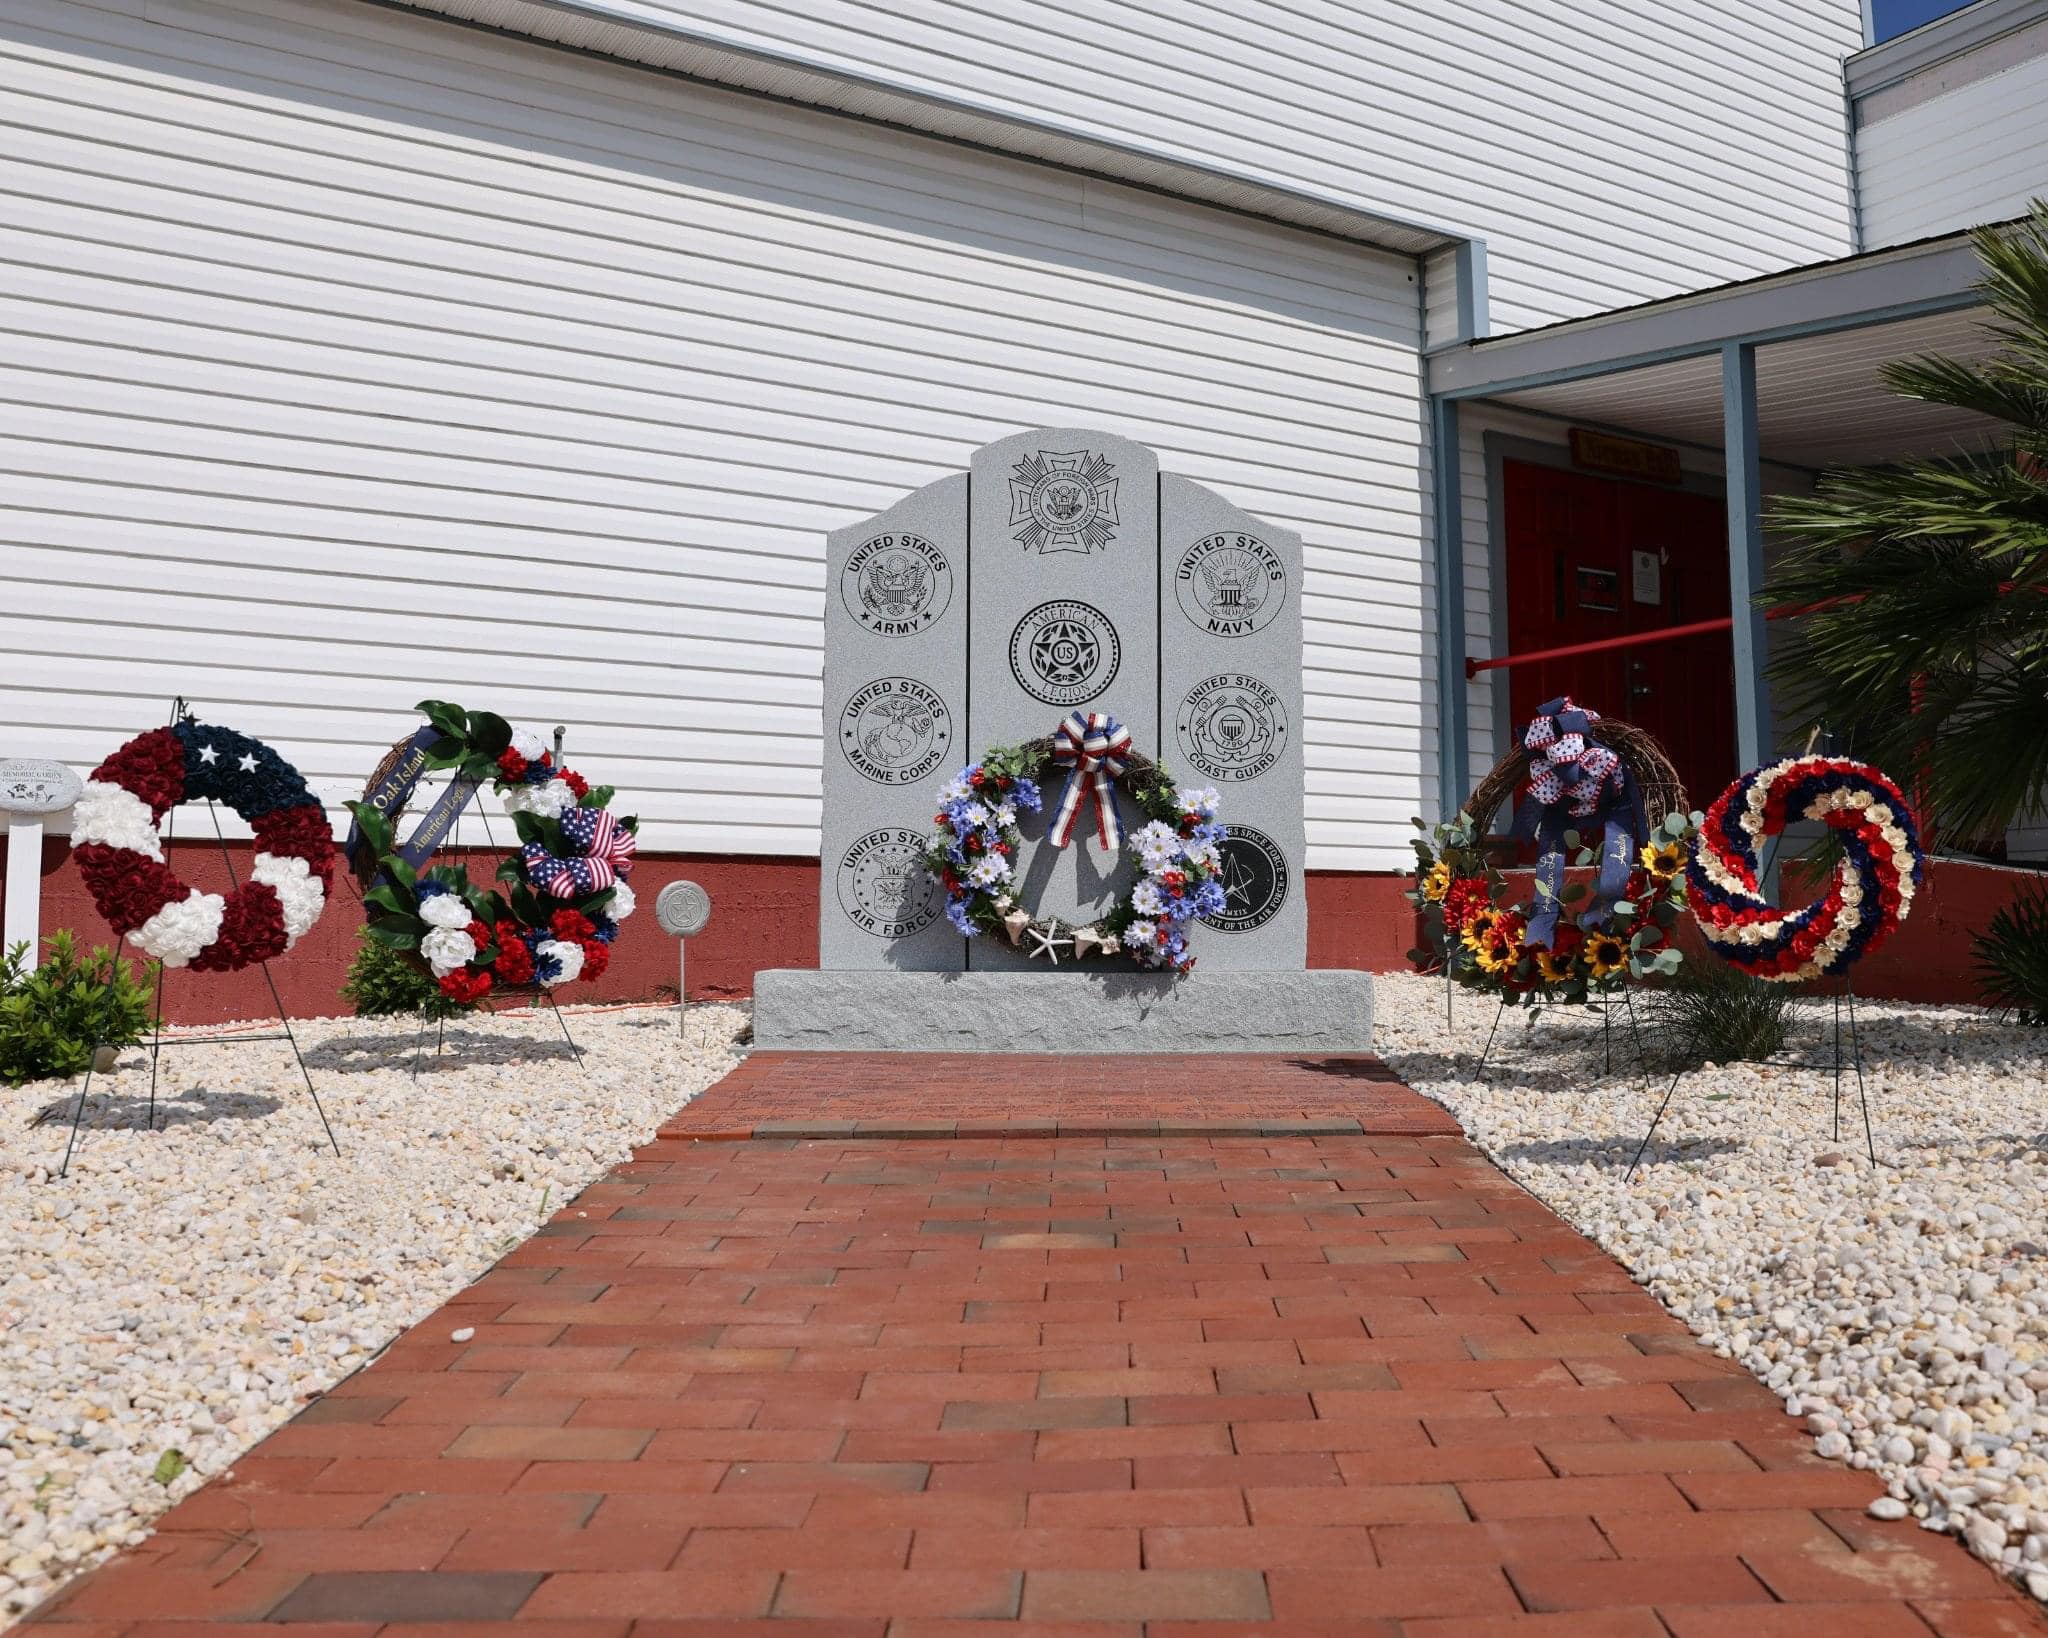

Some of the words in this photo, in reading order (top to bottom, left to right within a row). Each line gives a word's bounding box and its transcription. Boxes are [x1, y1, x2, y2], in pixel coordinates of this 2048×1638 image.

[1033, 477, 1051, 506] VETERANS
[1063, 472, 1089, 488] FOREIGN
[1088, 487, 1096, 506] WARS
[1040, 517, 1050, 528] THE
[1052, 524, 1076, 532] UNITED
[1078, 509, 1095, 527] STATES
[848, 536, 893, 573] UNITED
[901, 536, 946, 572] STATES
[1179, 536, 1225, 580] UNITED
[1236, 536, 1282, 581] STATES
[872, 619, 918, 635] ARMY
[1032, 609, 1100, 631] AMERICAN
[1208, 618, 1254, 635] NAVY
[1057, 647, 1073, 659] US
[847, 682, 892, 718] UNITED
[900, 682, 944, 719] STATES
[1042, 682, 1090, 698] LEGION
[1186, 676, 1228, 705] UNITED
[1235, 676, 1277, 706] STATES
[373, 782, 401, 809] Oak
[396, 747, 426, 785] Island
[849, 749, 894, 782] MARINE
[900, 751, 940, 781] CORPS
[1190, 752, 1229, 779] COAST
[1235, 753, 1275, 779] GUARD
[413, 808, 449, 854] American
[844, 832, 890, 868] UNITED
[1240, 828, 1268, 846] SPACE
[1266, 845, 1285, 873] FORCE
[851, 909, 875, 930] AIR
[884, 907, 936, 935] FORCE
[1224, 922, 1235, 930] OF
[1237, 919, 1256, 930] THE
[1258, 908, 1274, 921] AIR
[1270, 881, 1285, 909] FORCE
